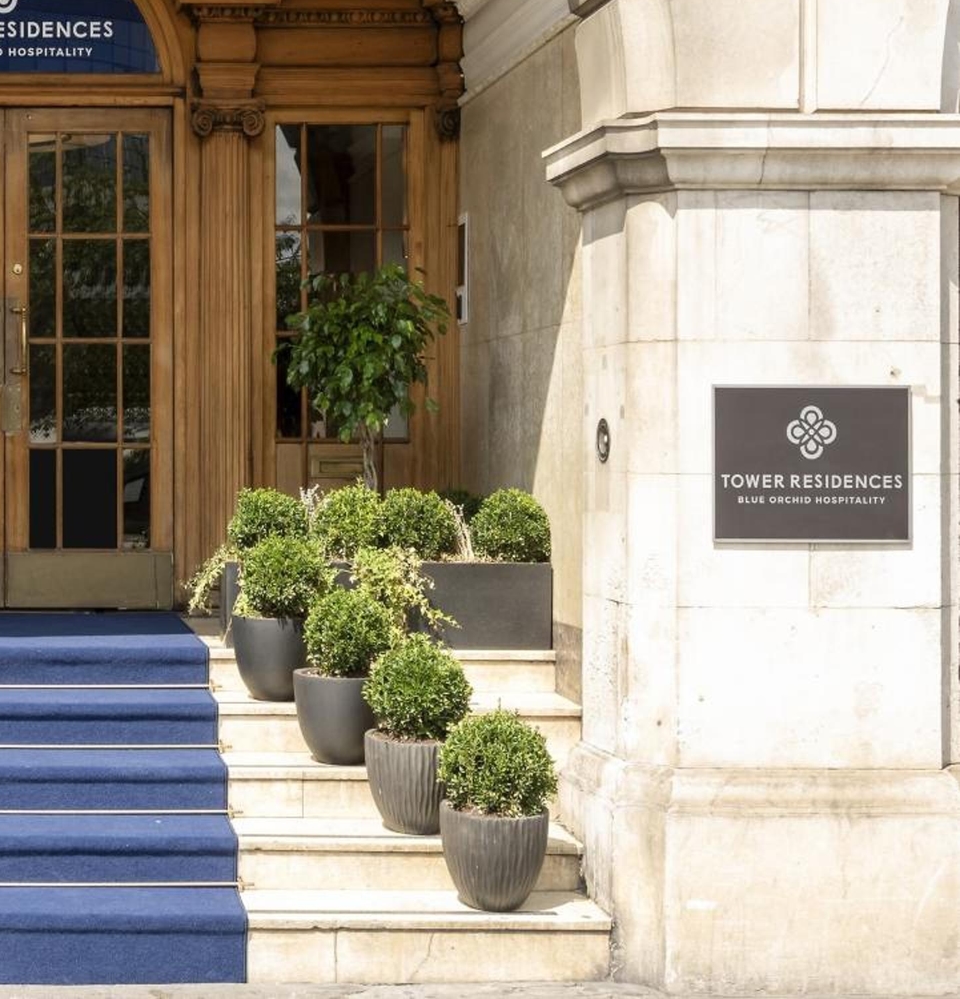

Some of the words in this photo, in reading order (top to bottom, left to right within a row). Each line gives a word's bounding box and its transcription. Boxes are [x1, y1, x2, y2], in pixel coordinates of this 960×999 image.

[8, 47, 93, 57] HOSPITALITY
[721, 474, 785, 489] TOWER
[790, 474, 903, 489] RESIDENCES
[737, 495, 765, 504] BLUE
[769, 496, 811, 504] ORCHID
[815, 496, 885, 504] HOSPITALITY
